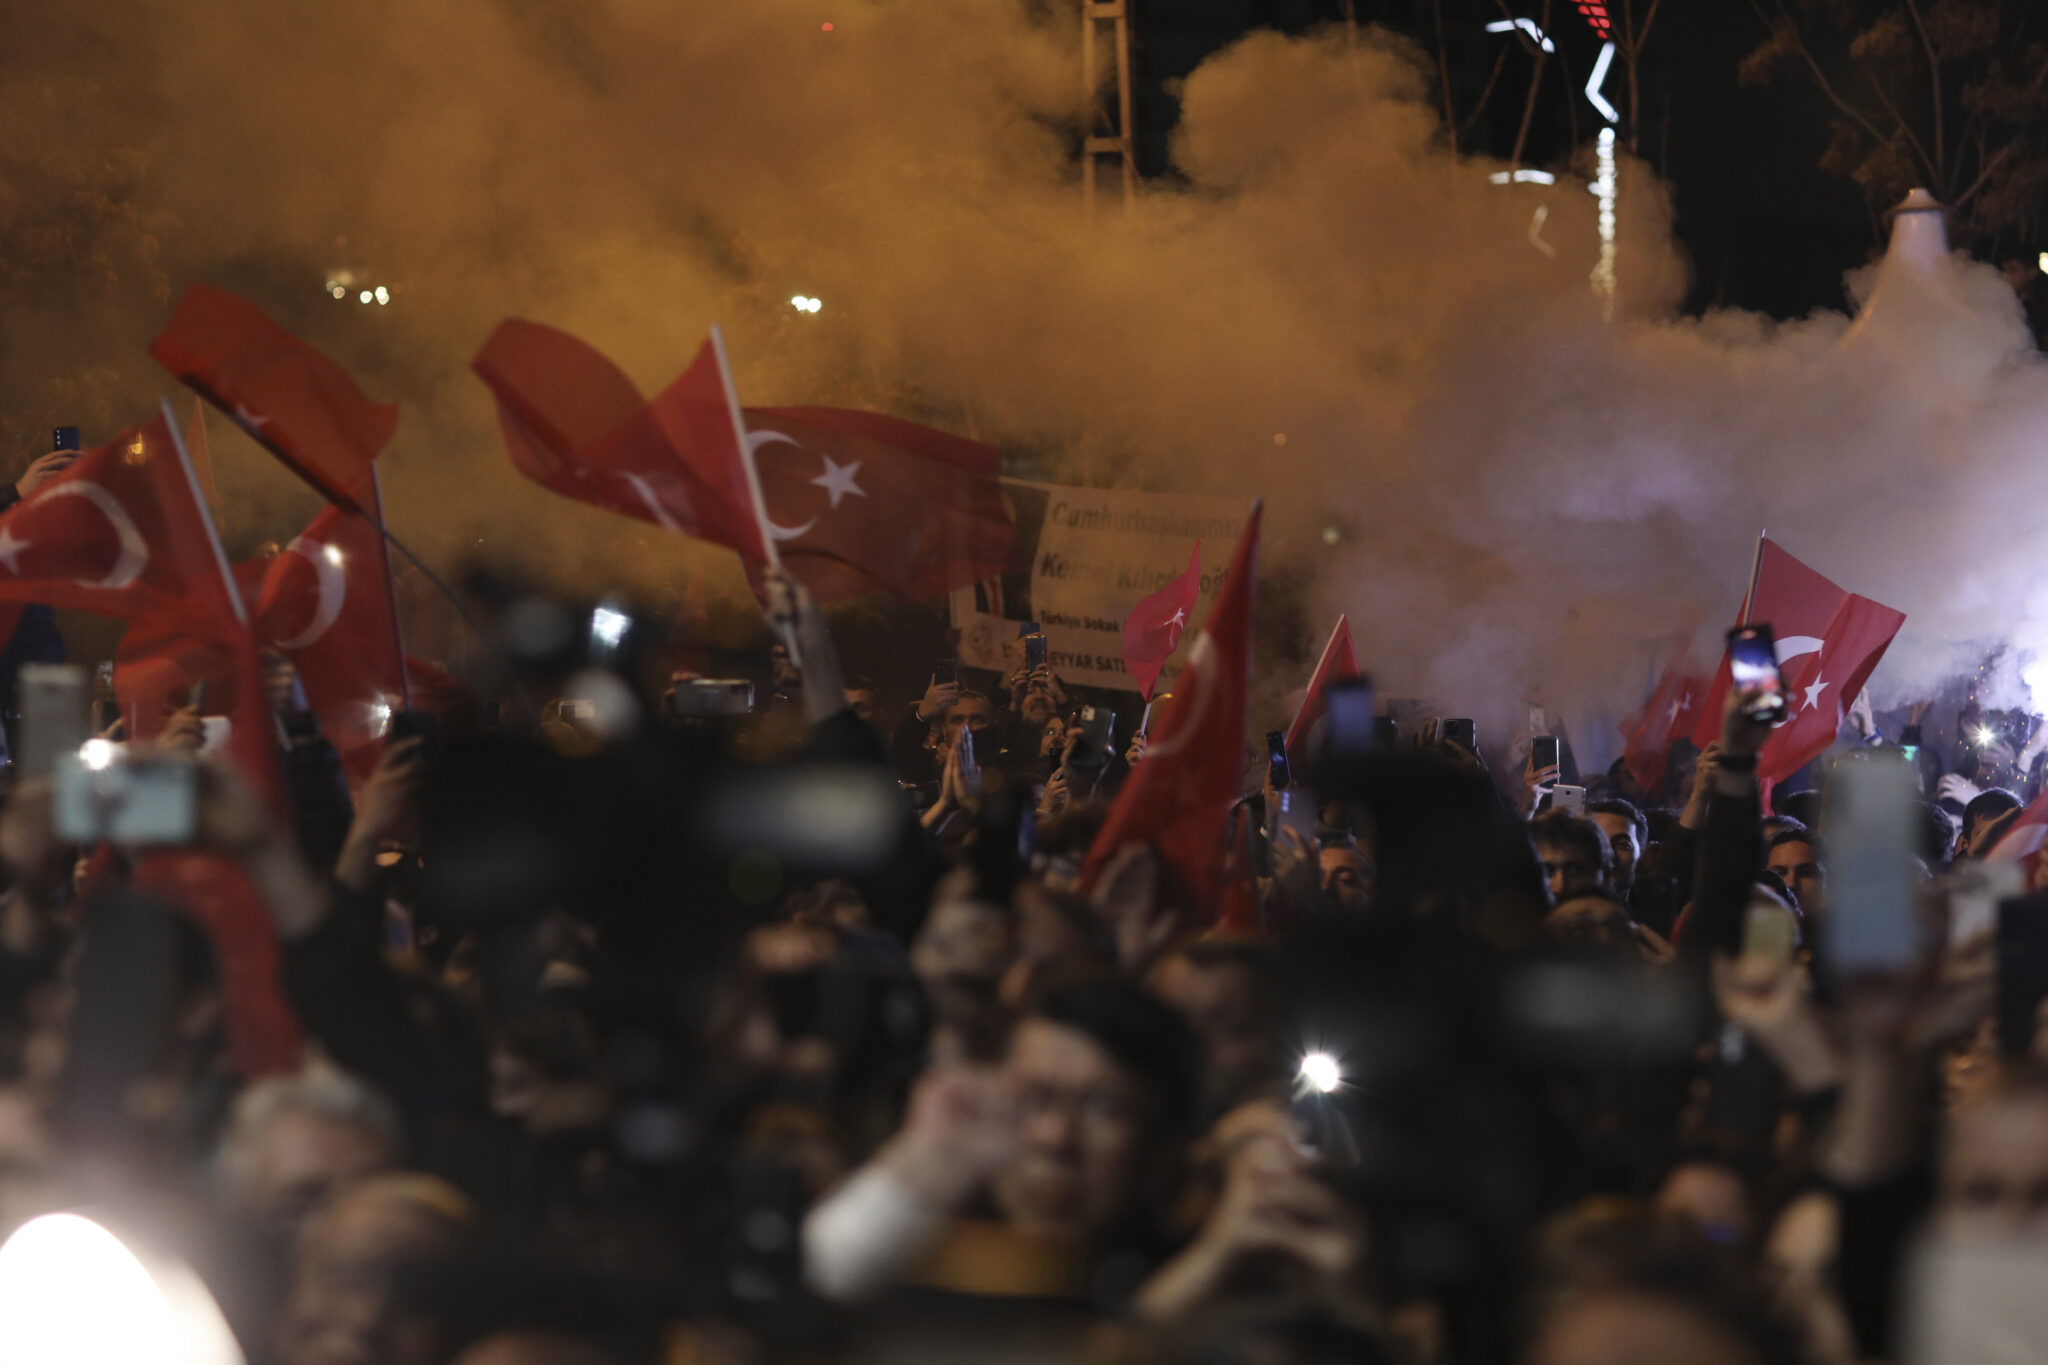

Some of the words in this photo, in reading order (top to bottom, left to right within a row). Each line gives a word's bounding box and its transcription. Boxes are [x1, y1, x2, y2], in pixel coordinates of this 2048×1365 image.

[1084, 616, 1120, 632] Sokak
[1051, 652, 1092, 668] EYYAR
[1096, 655, 1127, 673] SATI
